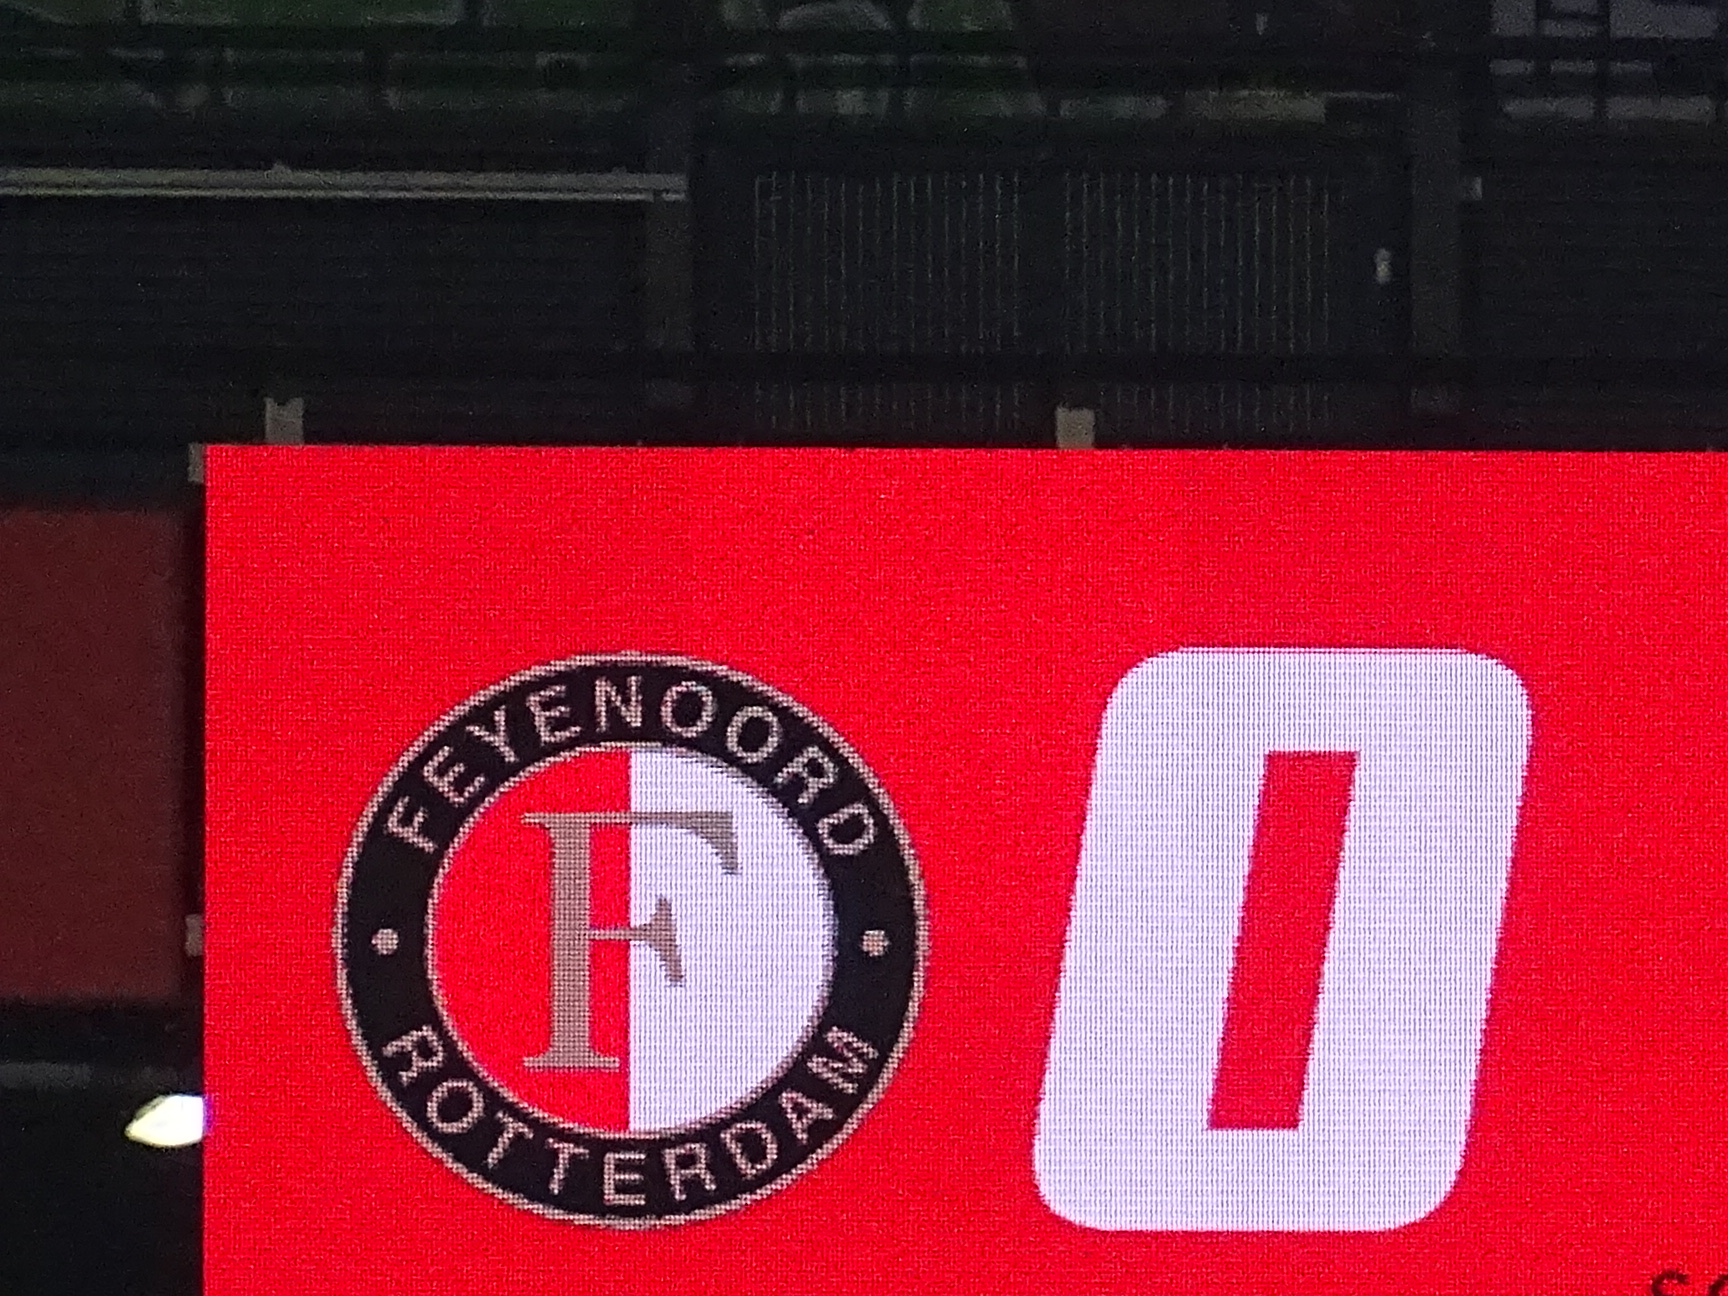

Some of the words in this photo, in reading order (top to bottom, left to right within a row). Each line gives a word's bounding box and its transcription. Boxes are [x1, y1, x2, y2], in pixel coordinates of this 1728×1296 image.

[384, 674, 878, 857] FEYENOORD
[522, 809, 741, 1072] F
[1031, 646, 1533, 1233] 0
[384, 1025, 879, 1208] ROTTERDAM
